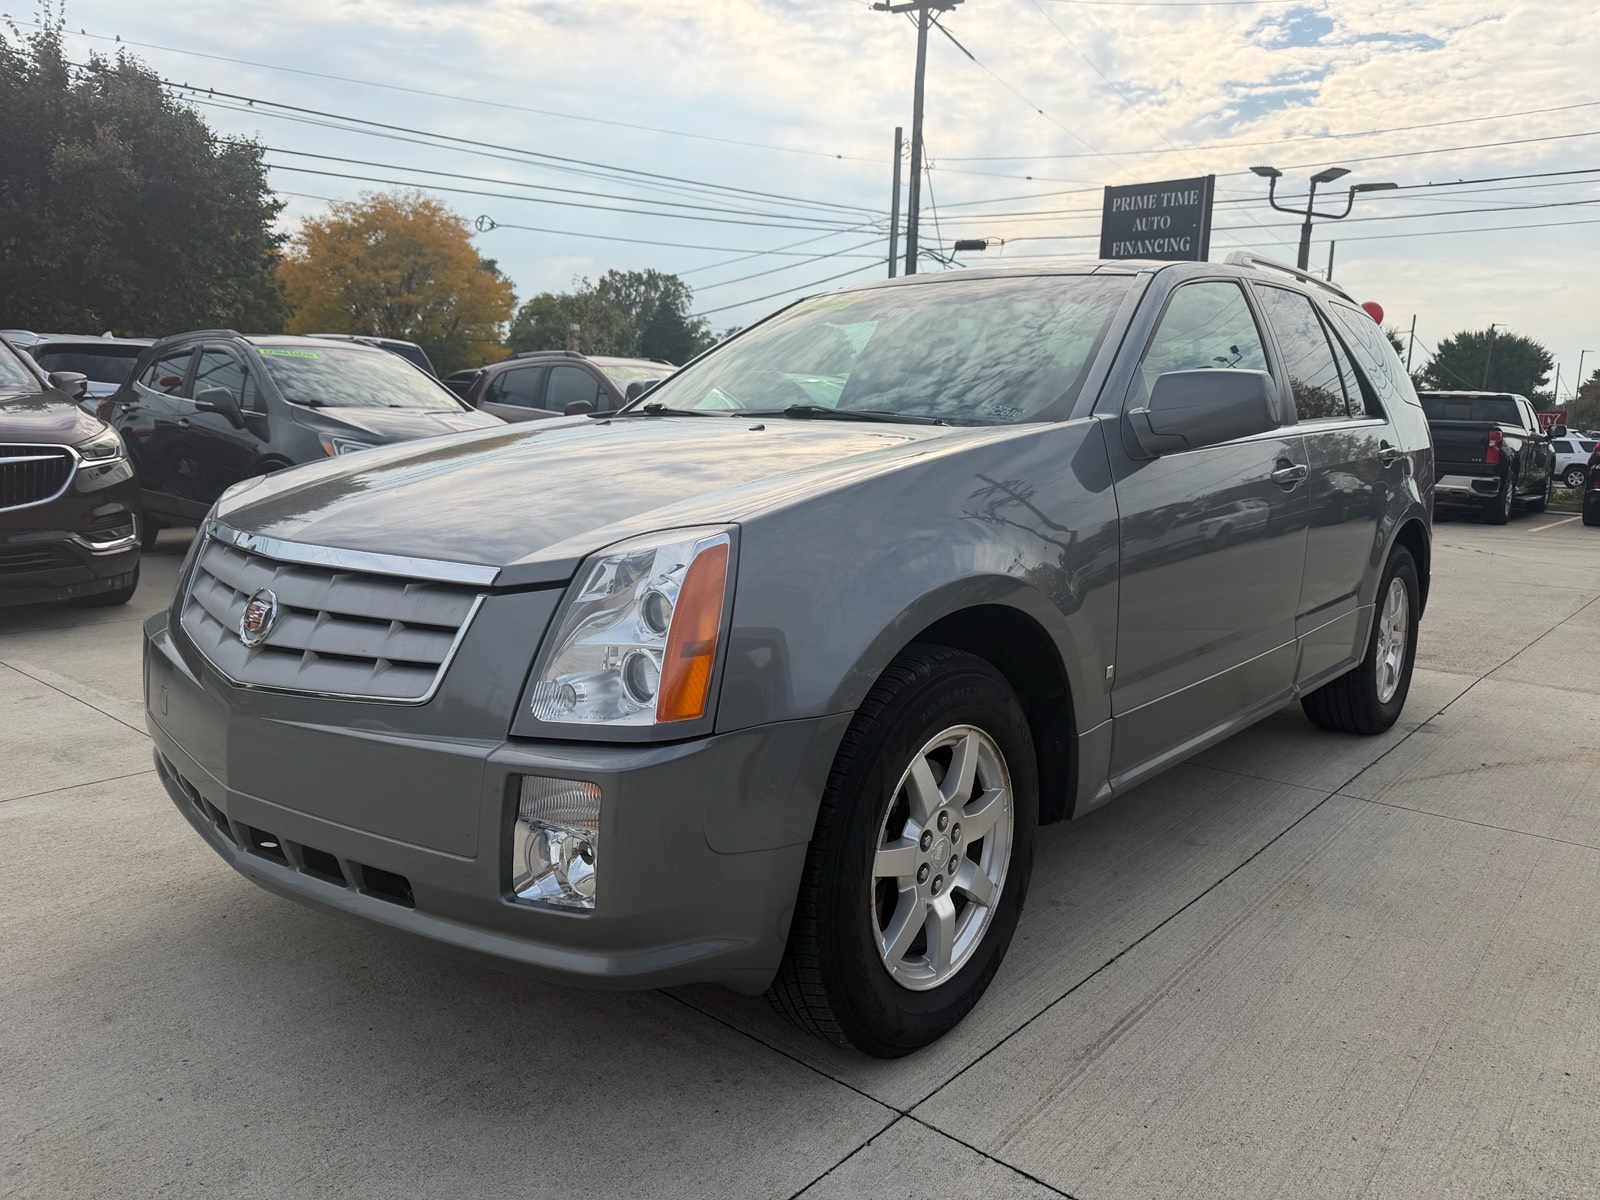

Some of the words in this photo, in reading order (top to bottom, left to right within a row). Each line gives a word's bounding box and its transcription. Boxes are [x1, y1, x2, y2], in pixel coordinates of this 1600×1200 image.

[1112, 194, 1157, 212] PRIME
[1161, 190, 1199, 207] TIME
[1132, 215, 1171, 232] AUTO
[1112, 237, 1190, 256] FINANCING
